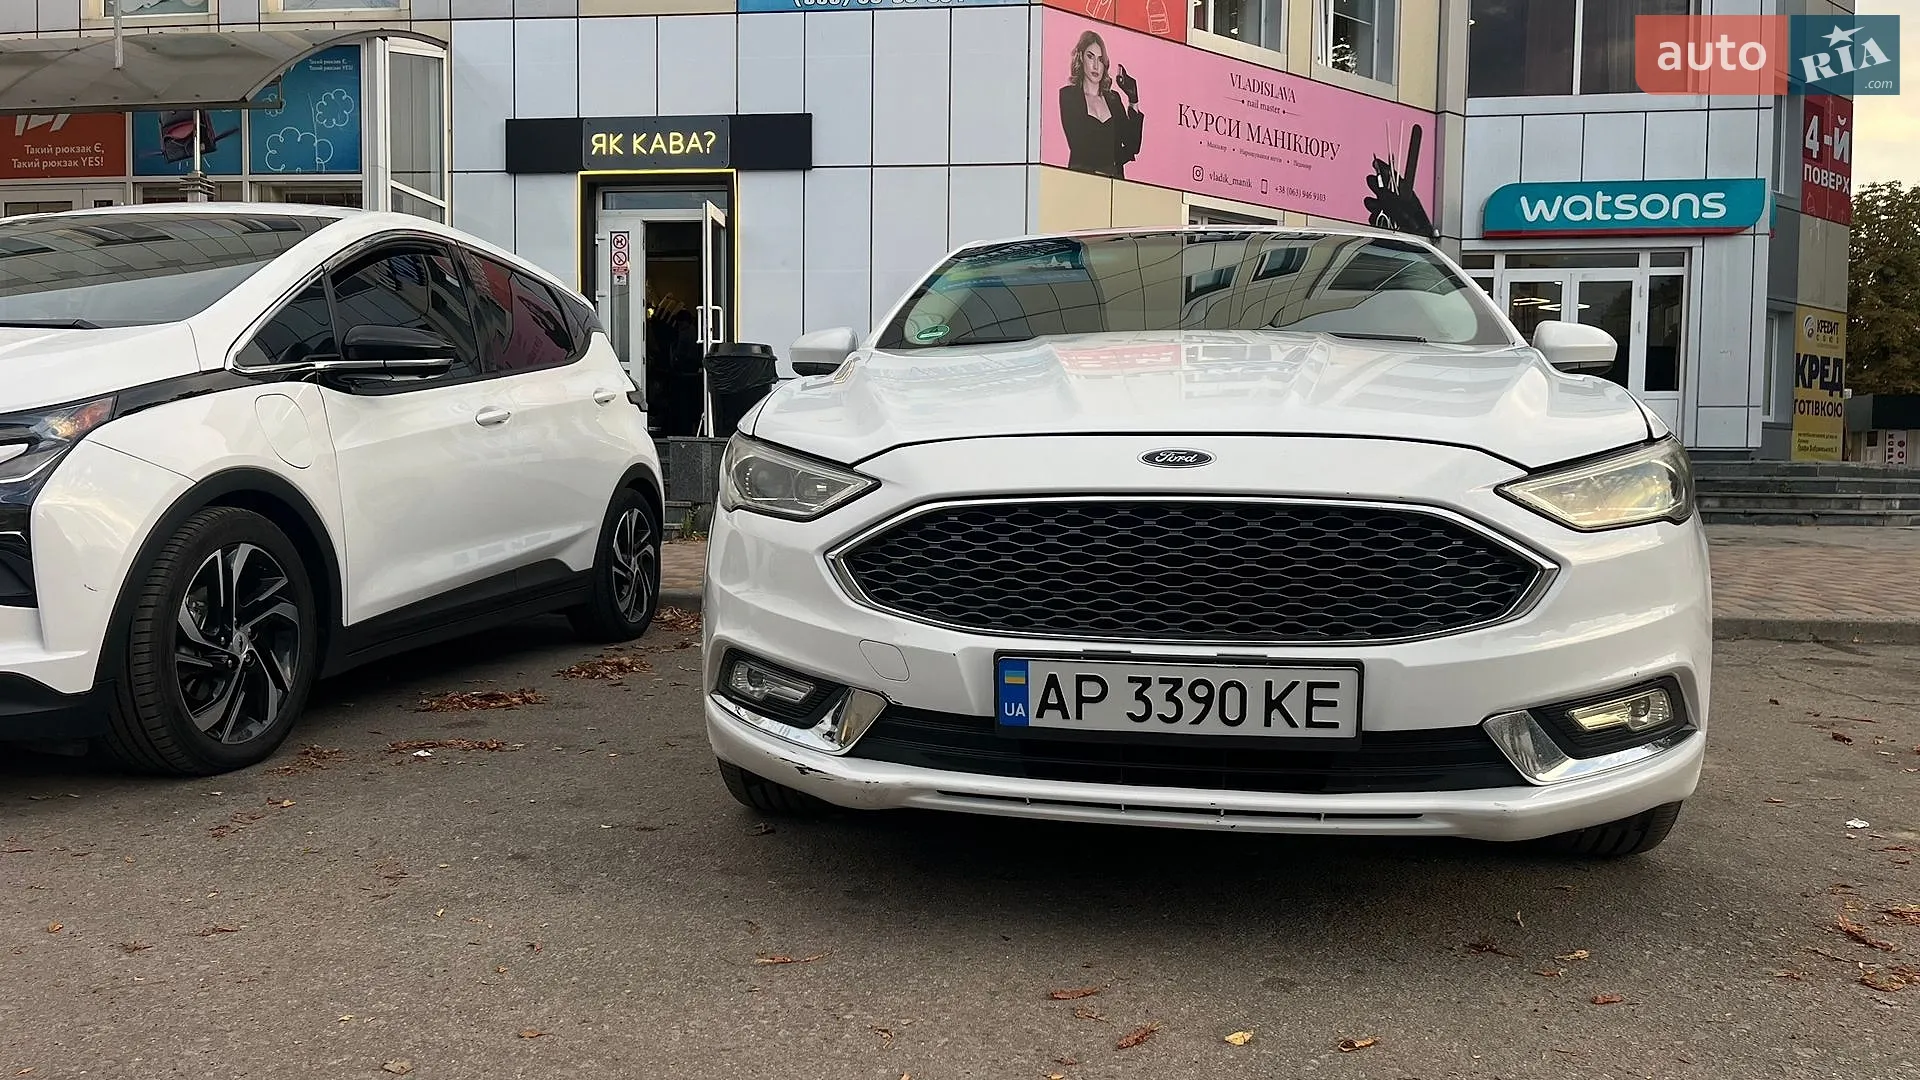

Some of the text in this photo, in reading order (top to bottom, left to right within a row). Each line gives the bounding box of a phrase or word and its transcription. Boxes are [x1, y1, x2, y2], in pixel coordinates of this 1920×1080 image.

[1230, 73, 1296, 103] VLADISLAVA
[1247, 99, 1280, 115] nail master
[24, 142, 104, 155] Такий рюкзак Є,
[591, 131, 716, 155] ЯК КАВА?
[1247, 123, 1340, 161] МАНІКЮРУ
[12, 156, 104, 170] Такий рюкзак YES!
[1209, 172, 1252, 188] vladik_manik
[1804, 164, 1850, 194] ПОВЕРХ
[1275, 186, 1285, 194] +38
[1520, 191, 1727, 222] watsons
[1795, 353, 1844, 398] КРЕД
[1155, 451, 1198, 462] Ford
[1004, 701, 1026, 718] UA
[1126, 675, 1248, 727] 3390
[1263, 680, 1340, 729] KE
